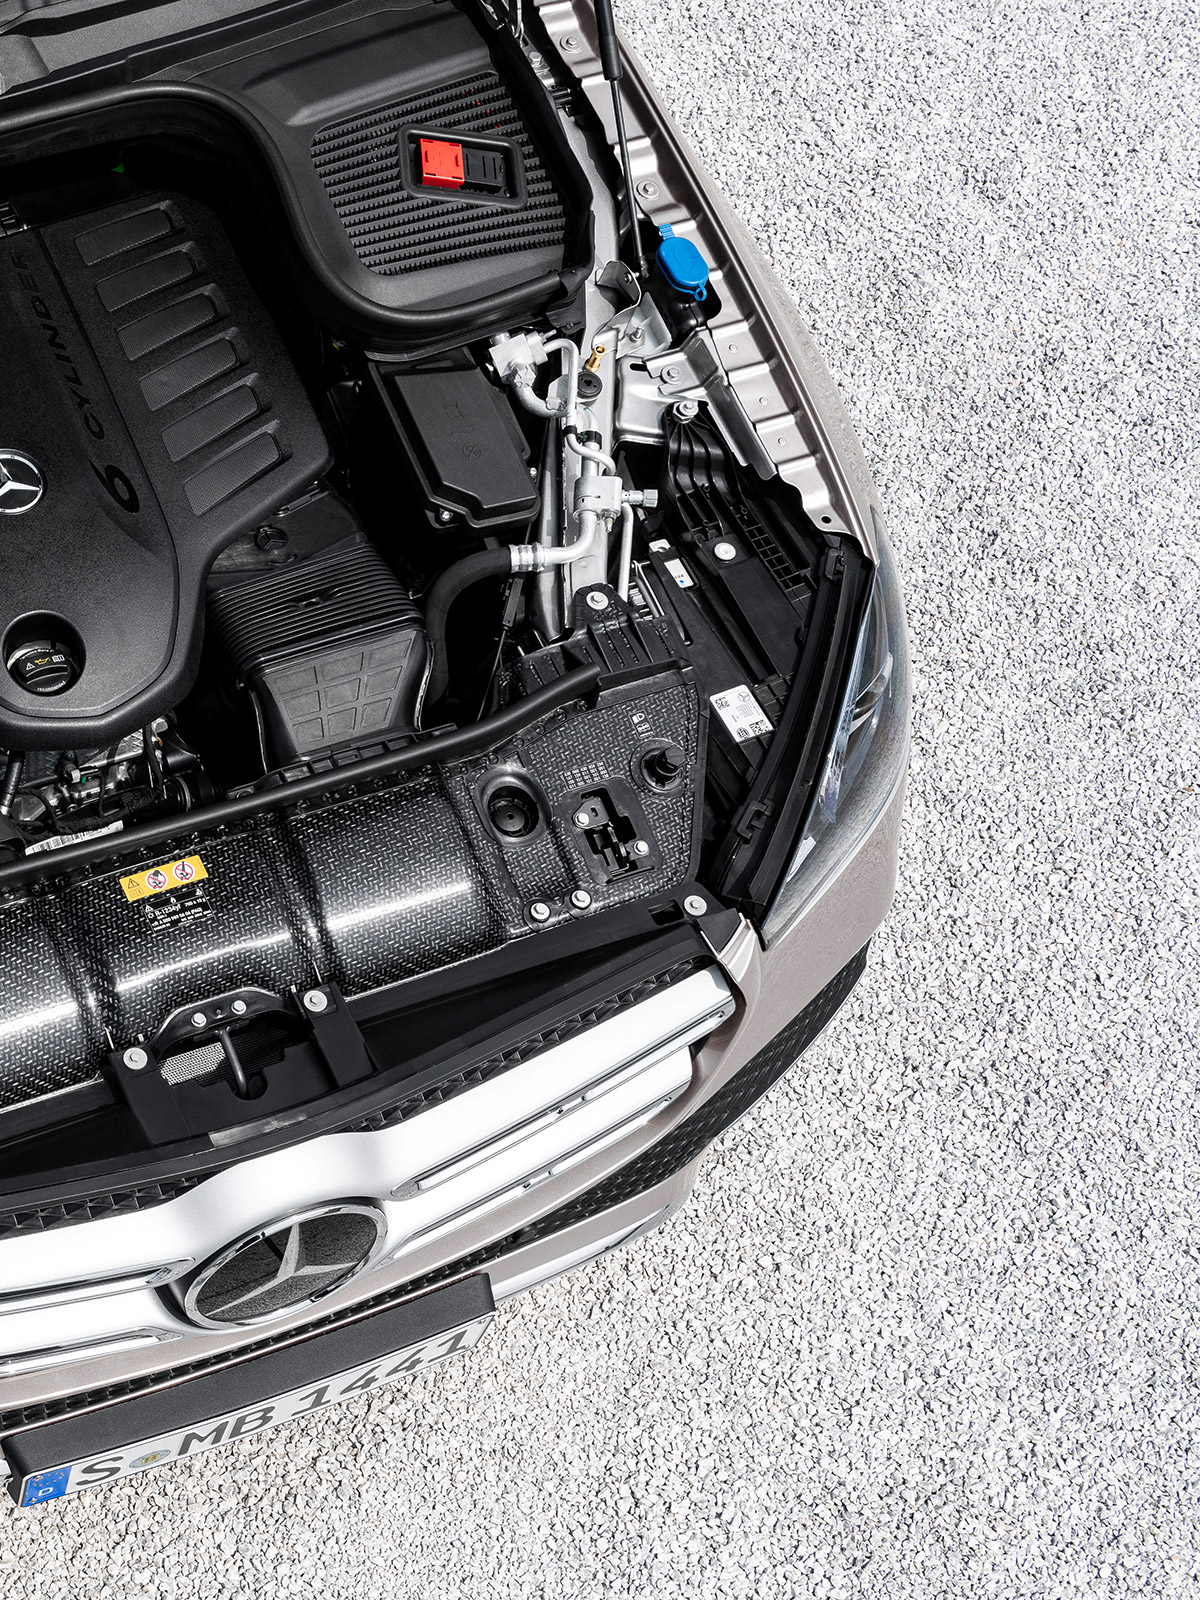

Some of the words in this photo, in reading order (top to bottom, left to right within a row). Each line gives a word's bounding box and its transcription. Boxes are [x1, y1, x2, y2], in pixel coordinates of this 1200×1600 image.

[78, 1456, 124, 1487] S
[177, 1405, 277, 1457] MB
[291, 1330, 470, 1417] 1441
[38, 1487, 54, 1497] D
